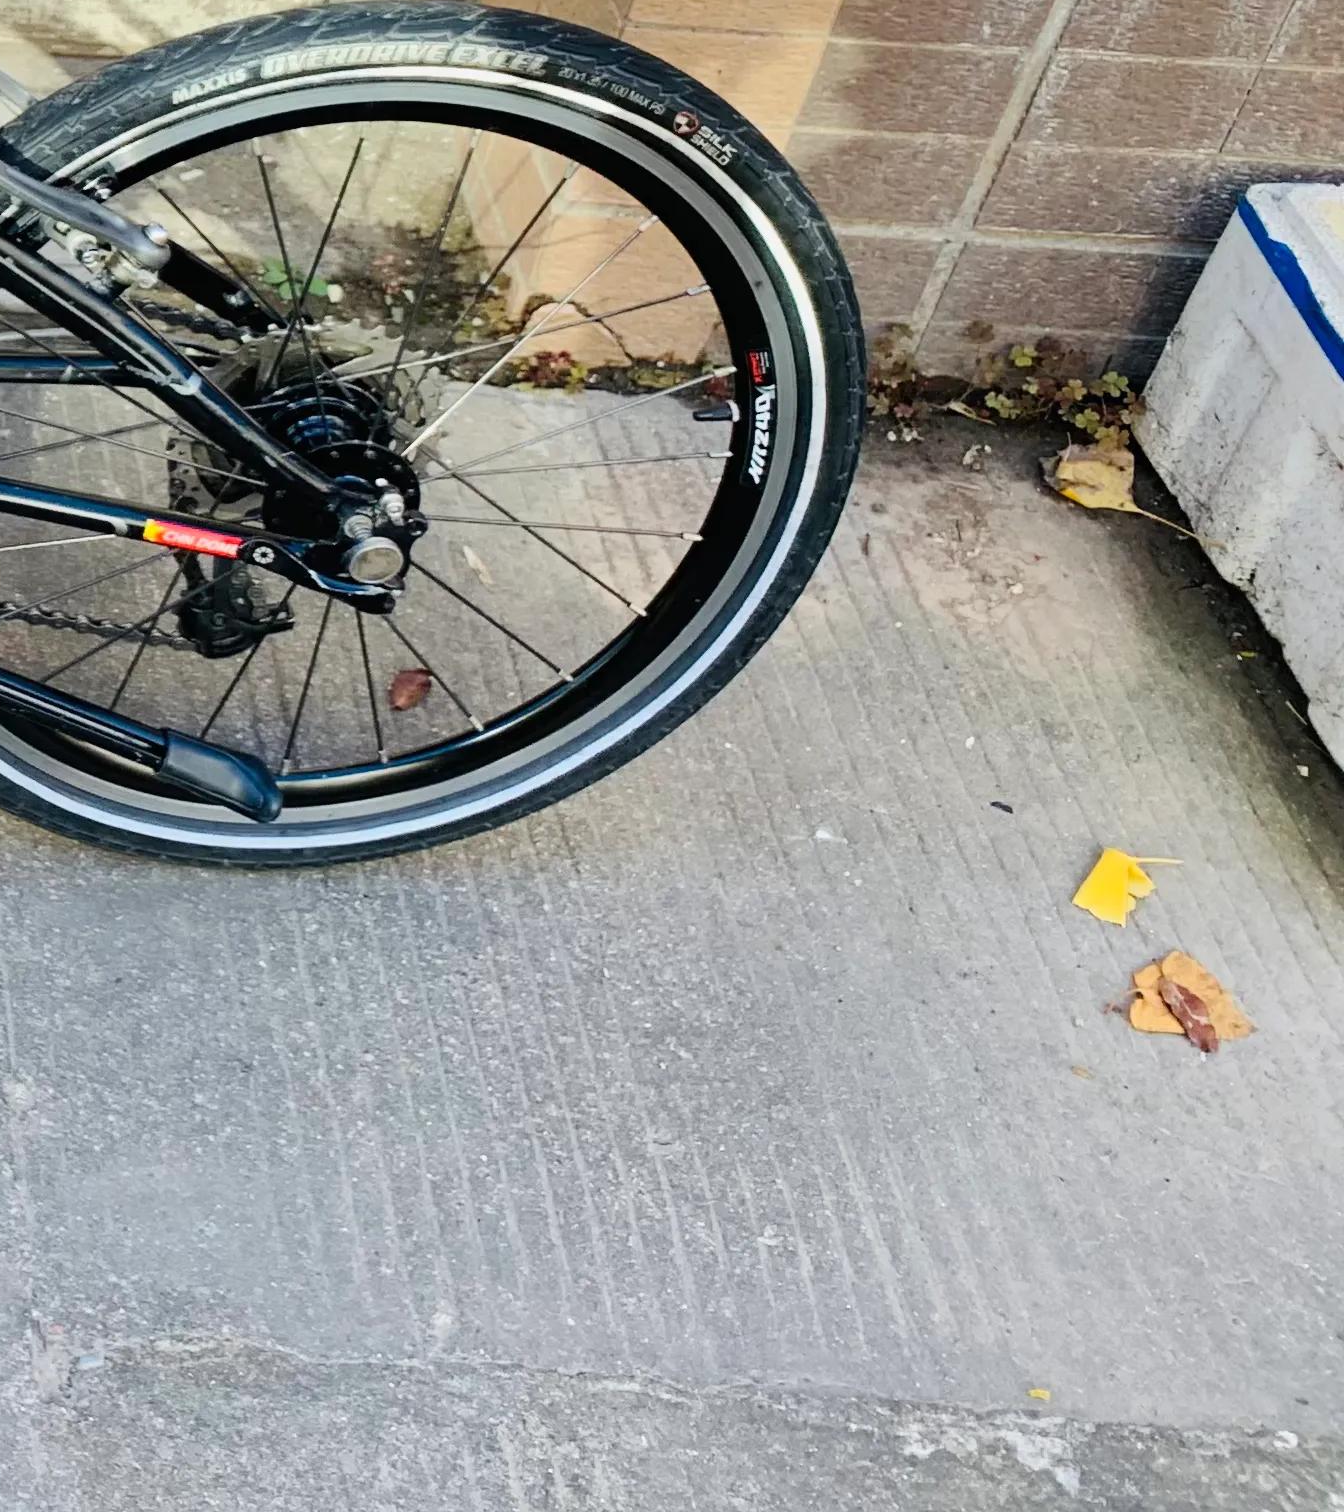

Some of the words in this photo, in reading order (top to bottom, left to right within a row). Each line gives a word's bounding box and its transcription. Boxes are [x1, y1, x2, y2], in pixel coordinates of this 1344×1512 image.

[172, 68, 247, 105] MAXXIS
[260, 43, 448, 79] OVERDRIVE
[446, 44, 549, 76] EXCEL
[691, 134, 730, 166] SHIELD
